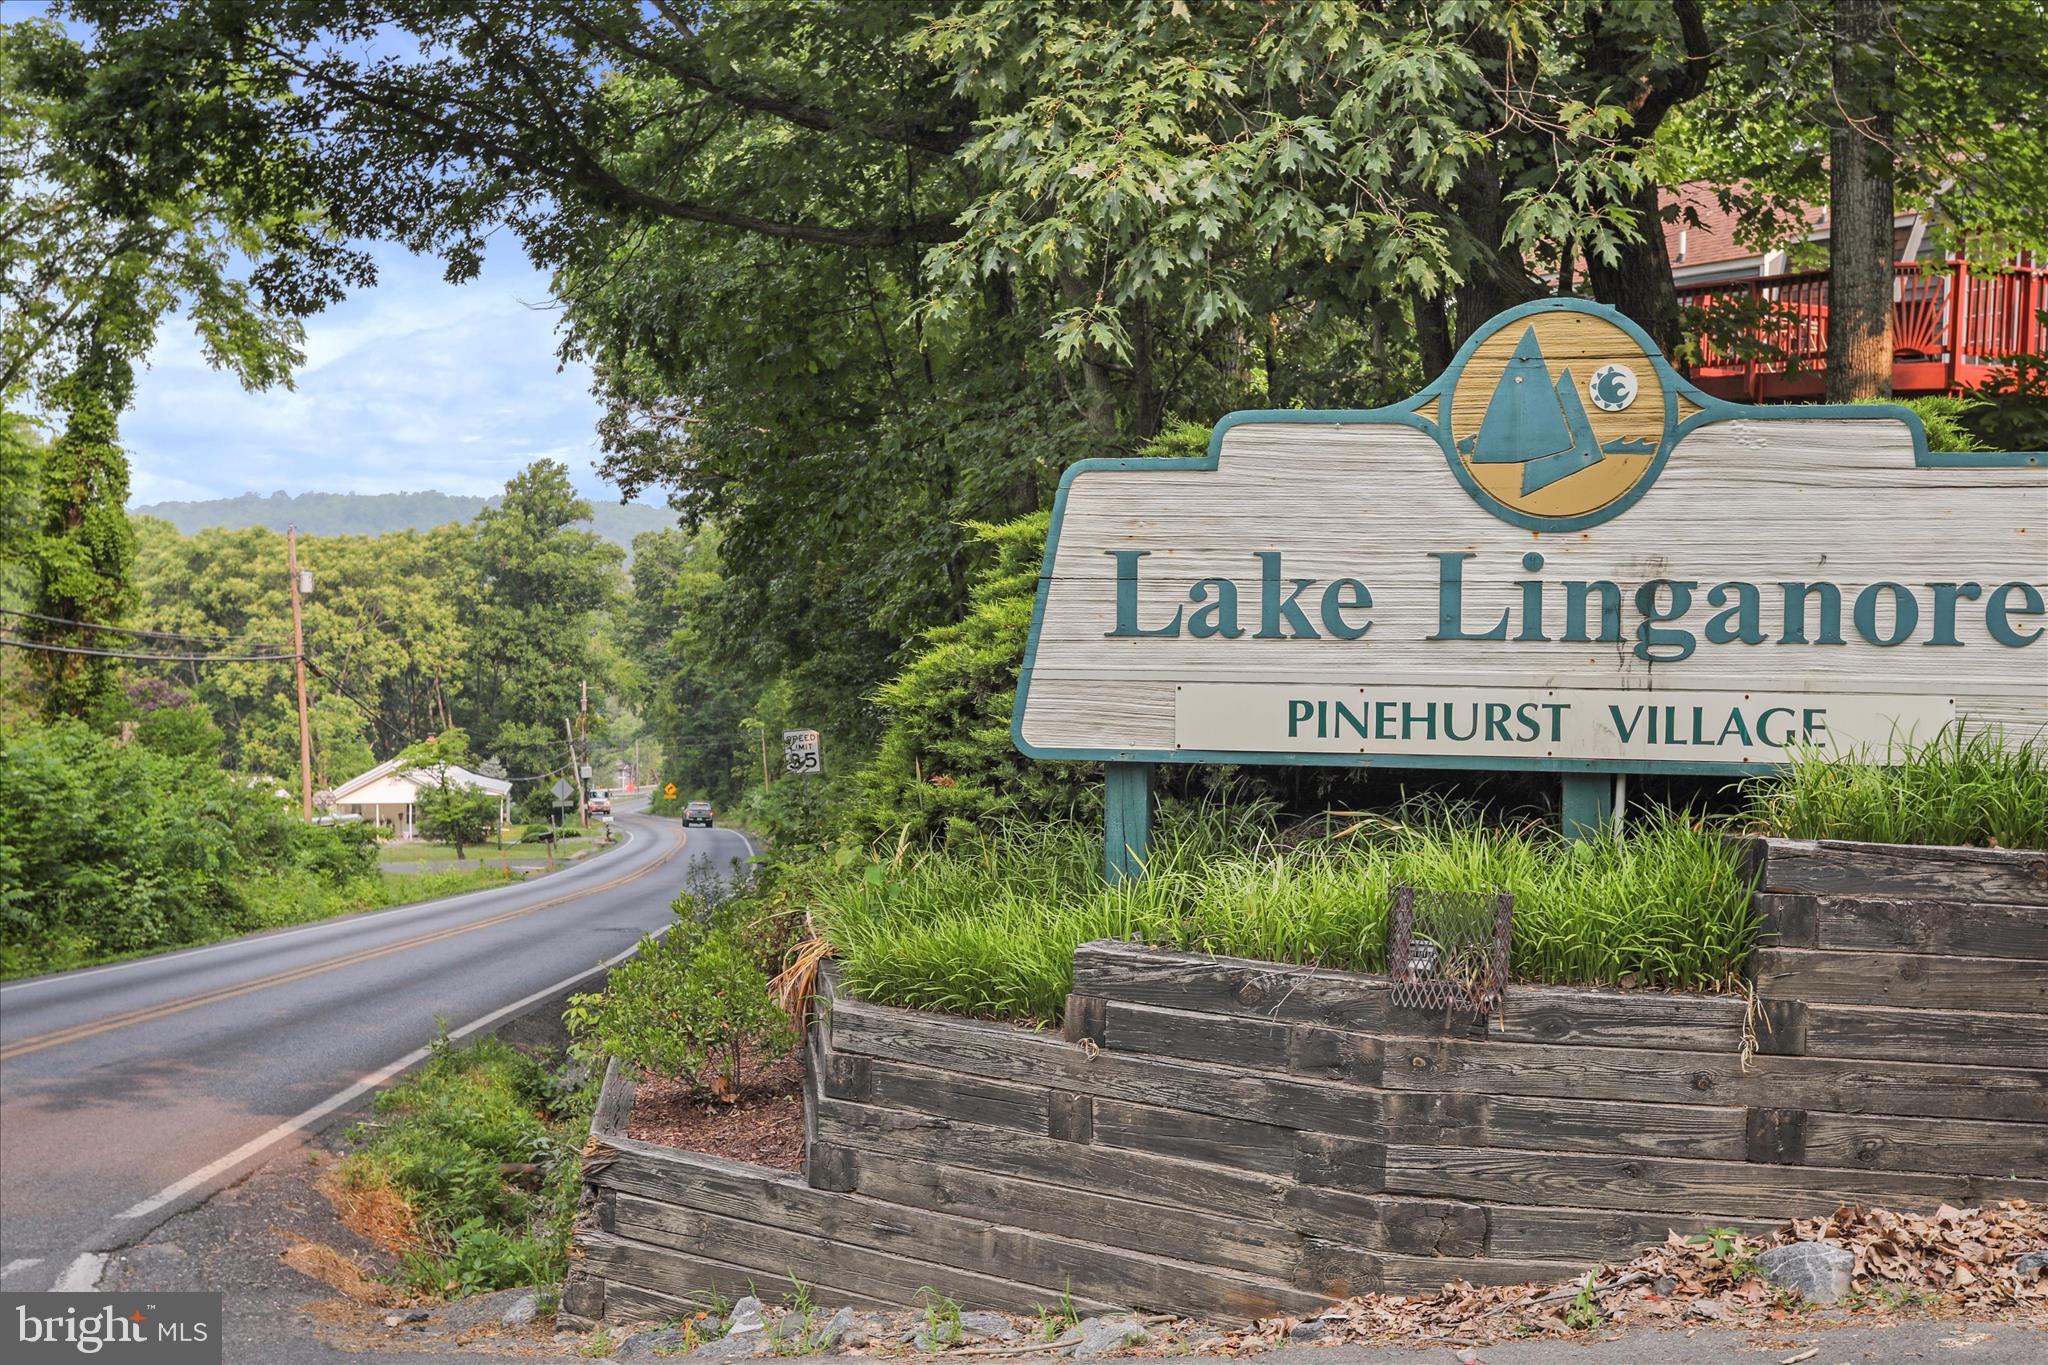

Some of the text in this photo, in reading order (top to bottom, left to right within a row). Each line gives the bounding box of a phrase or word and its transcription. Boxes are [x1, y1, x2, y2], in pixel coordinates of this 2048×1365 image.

[1104, 550, 2045, 662] Lake Linganore
[1287, 700, 1827, 748] PINEHURST VILLAGE
[790, 752, 817, 769] 35
